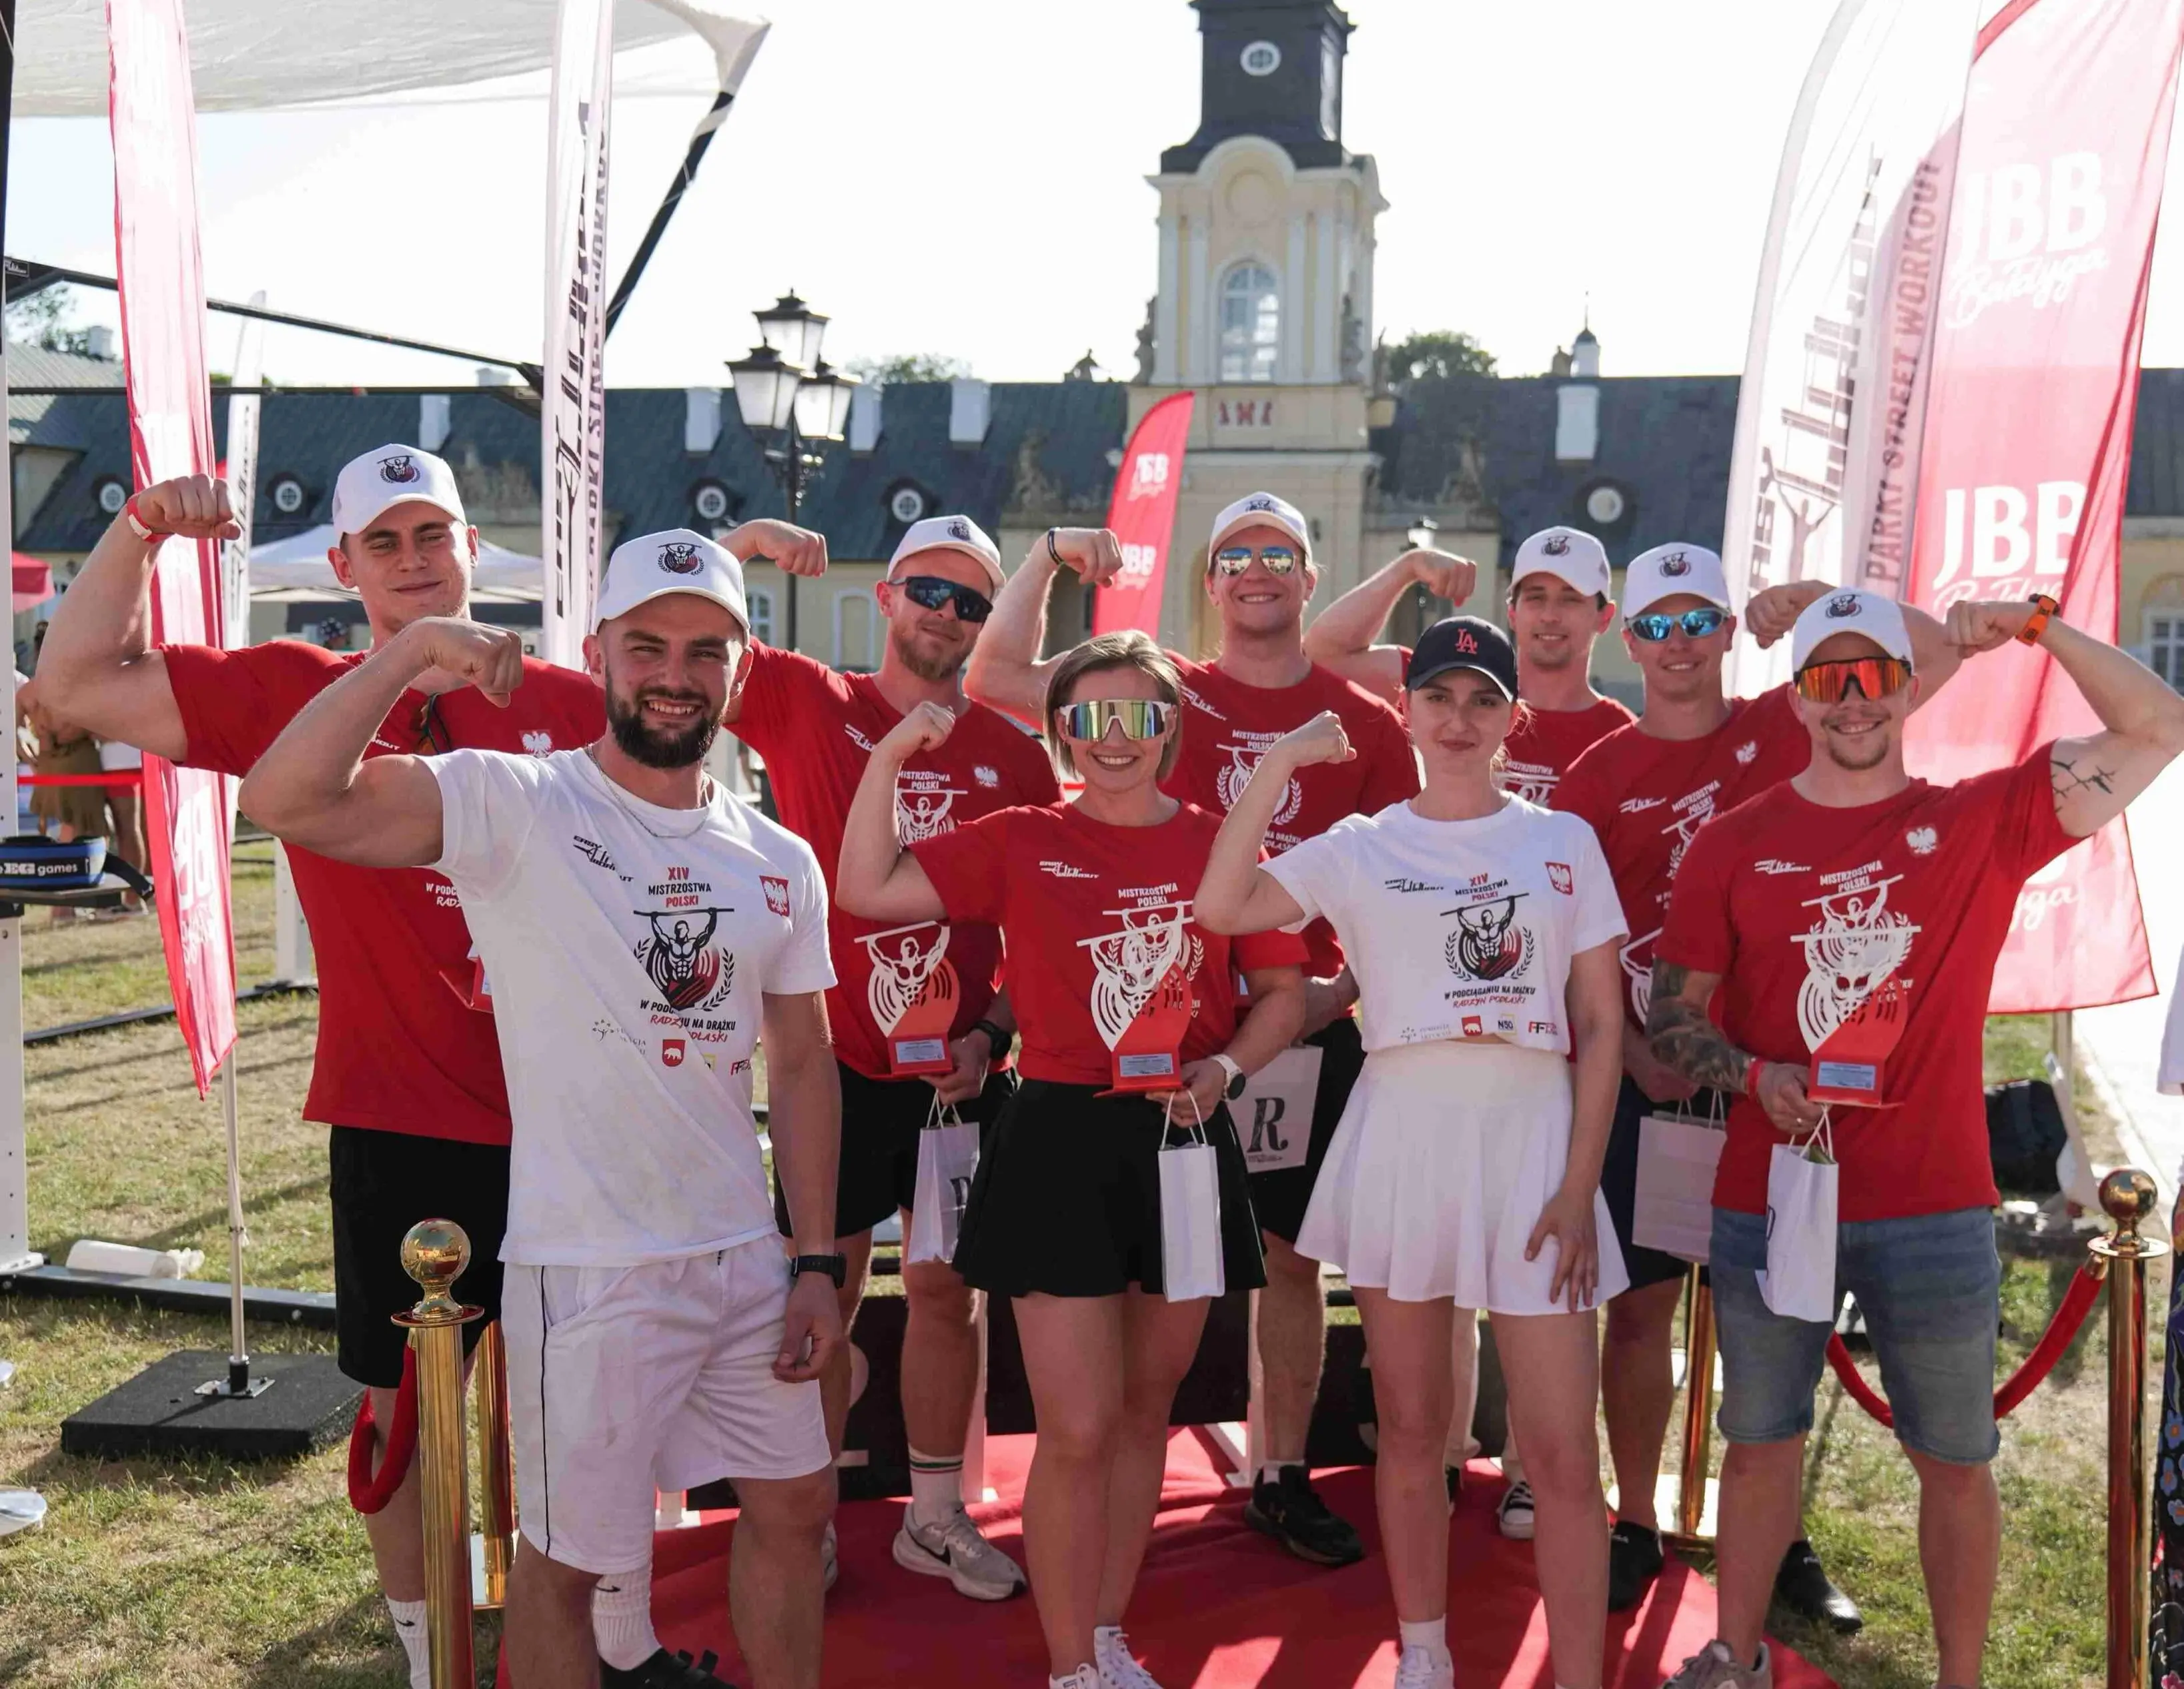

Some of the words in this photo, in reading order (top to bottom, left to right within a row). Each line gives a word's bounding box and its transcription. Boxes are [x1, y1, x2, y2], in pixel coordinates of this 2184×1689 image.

[1951, 151, 2107, 268] JBB
[1893, 157, 1942, 336] WORKOUT
[1880, 348, 1921, 468] STREET
[1866, 475, 1906, 582] PARKI
[1934, 482, 2088, 589] JBB
[1455, 628, 1478, 655] LA
[911, 780, 939, 790] POLSKI
[1671, 779, 1721, 813] MISTRZOSTWA
[37, 863, 78, 877] games
[668, 867, 690, 881] XIV
[1819, 859, 1884, 887] MISTRZOSTWA
[1455, 878, 1510, 896] MISTRZOSTWA
[1469, 872, 1489, 887] XIV
[1838, 875, 1870, 893] POLSKI
[426, 883, 434, 893] W
[648, 882, 712, 895] MISTRZOSTWA
[1117, 882, 1179, 899] MISTRZOSTWA
[666, 895, 700, 908] POLSKI
[1137, 895, 1168, 908] POLSKI
[1471, 891, 1500, 902] POLSKI
[1452, 985, 1500, 999] PODCIĄGANIU
[1502, 985, 1511, 993] NA
[640, 999, 650, 1010] W
[692, 1019, 704, 1029] NA
[706, 1019, 736, 1033] DRĄŻKU
[688, 1031, 728, 1043] DŁASKI
[1247, 1097, 1289, 1155] R
